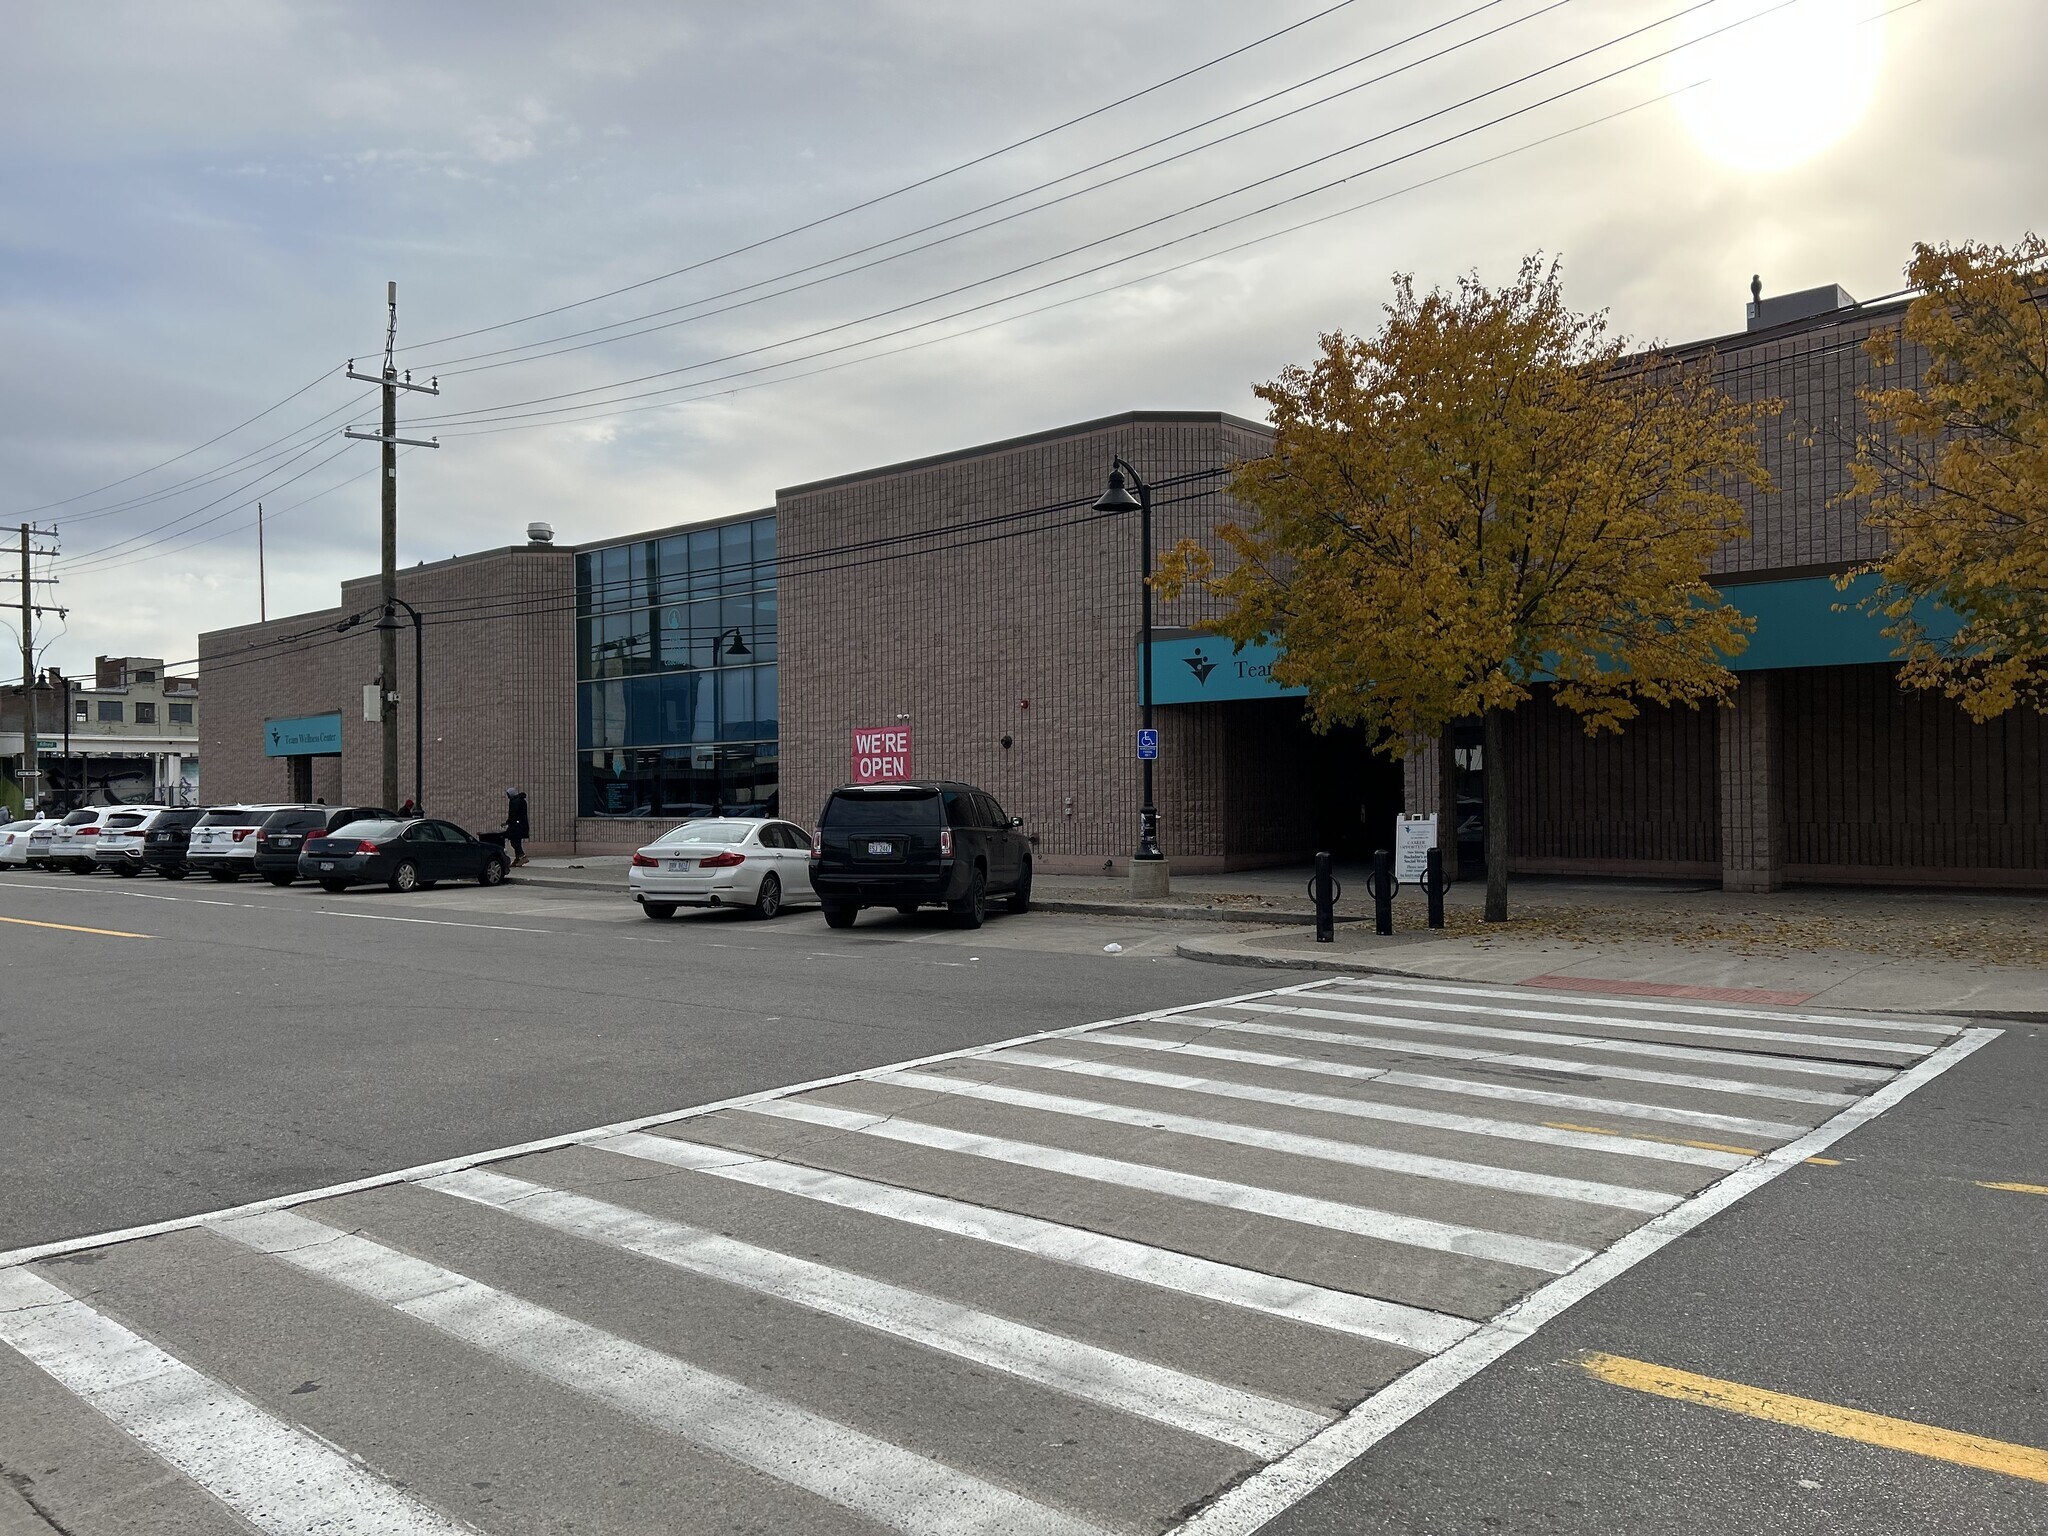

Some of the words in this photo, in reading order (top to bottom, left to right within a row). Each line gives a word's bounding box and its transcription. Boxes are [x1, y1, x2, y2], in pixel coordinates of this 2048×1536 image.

[1233, 660, 1272, 678] Tea
[285, 735, 298, 744] Team
[299, 734, 320, 743] Wellness
[320, 732, 336, 742] Center
[856, 732, 907, 754] WE'RE
[860, 756, 904, 778] OPEN
